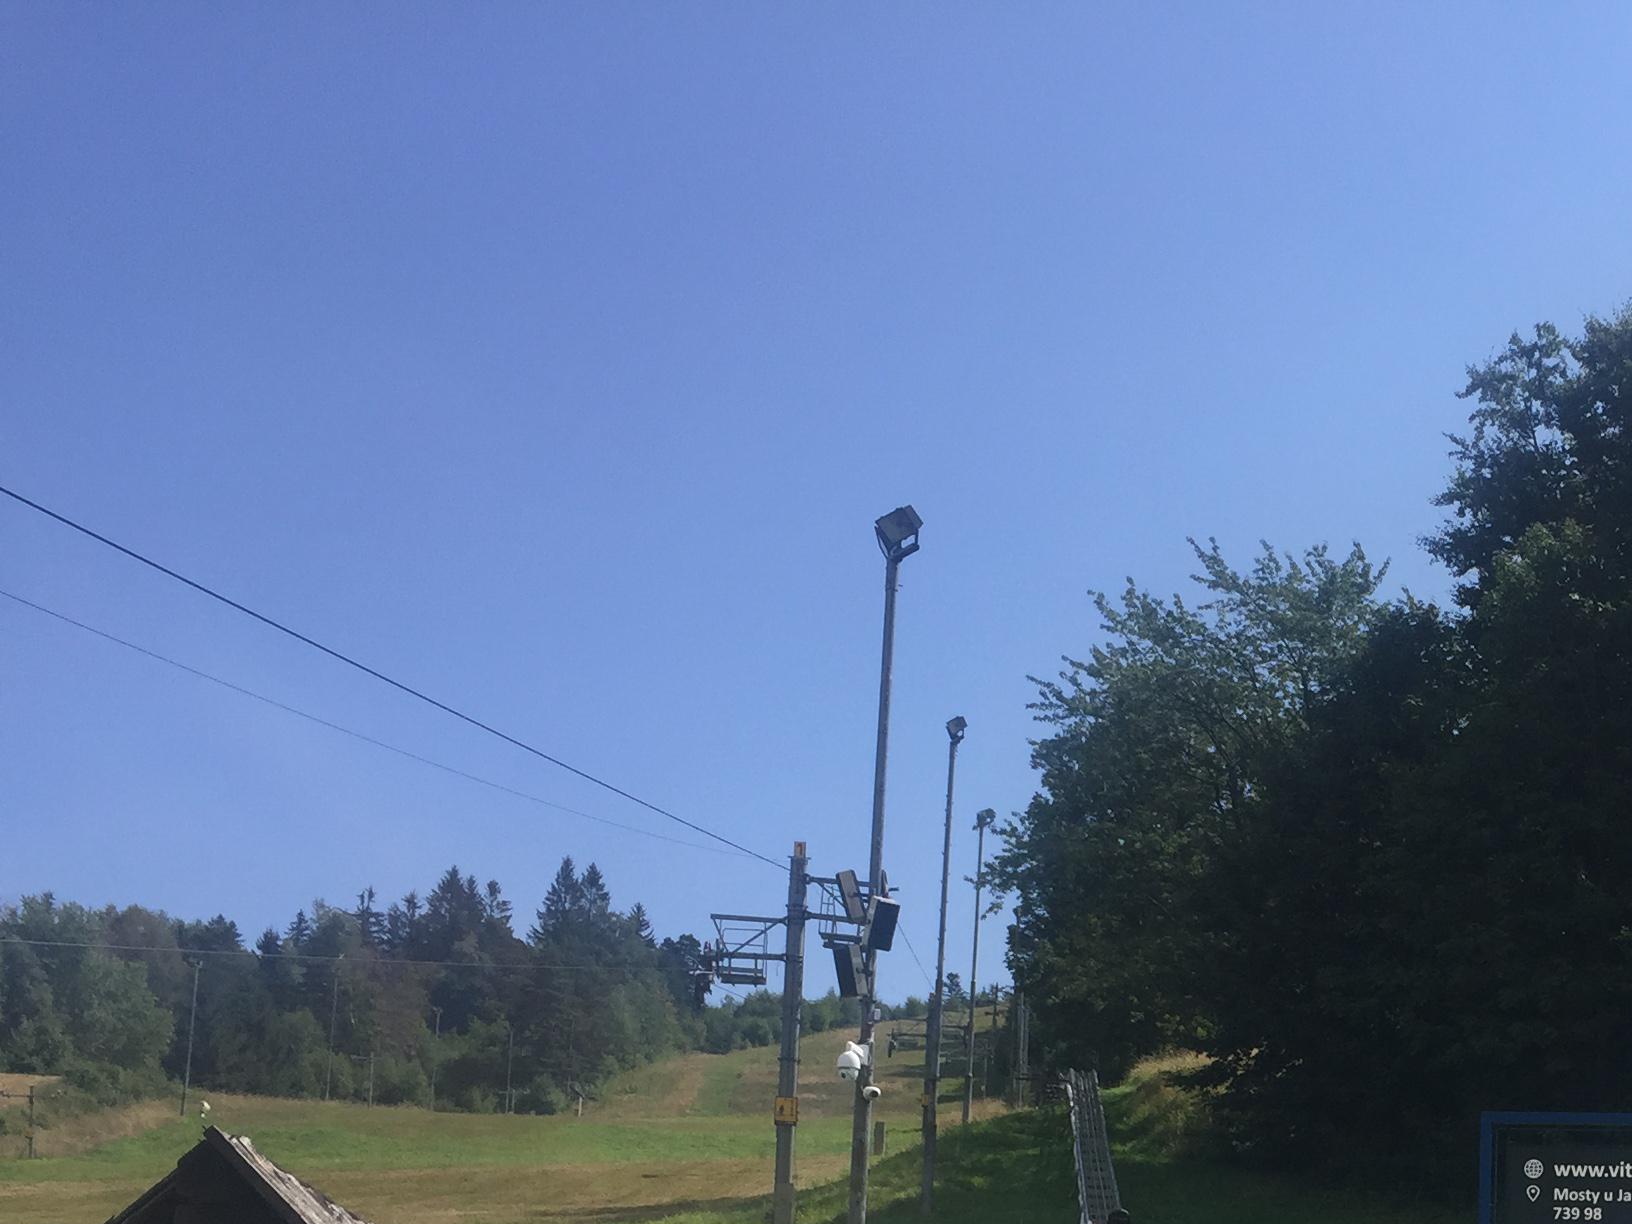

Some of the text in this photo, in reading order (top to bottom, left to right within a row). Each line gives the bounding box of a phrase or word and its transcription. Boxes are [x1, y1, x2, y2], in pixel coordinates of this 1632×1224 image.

[1553, 1187, 1600, 1204] Mosty
[1604, 1191, 1613, 1202] u
[1553, 1206, 1602, 1221] 739 98
